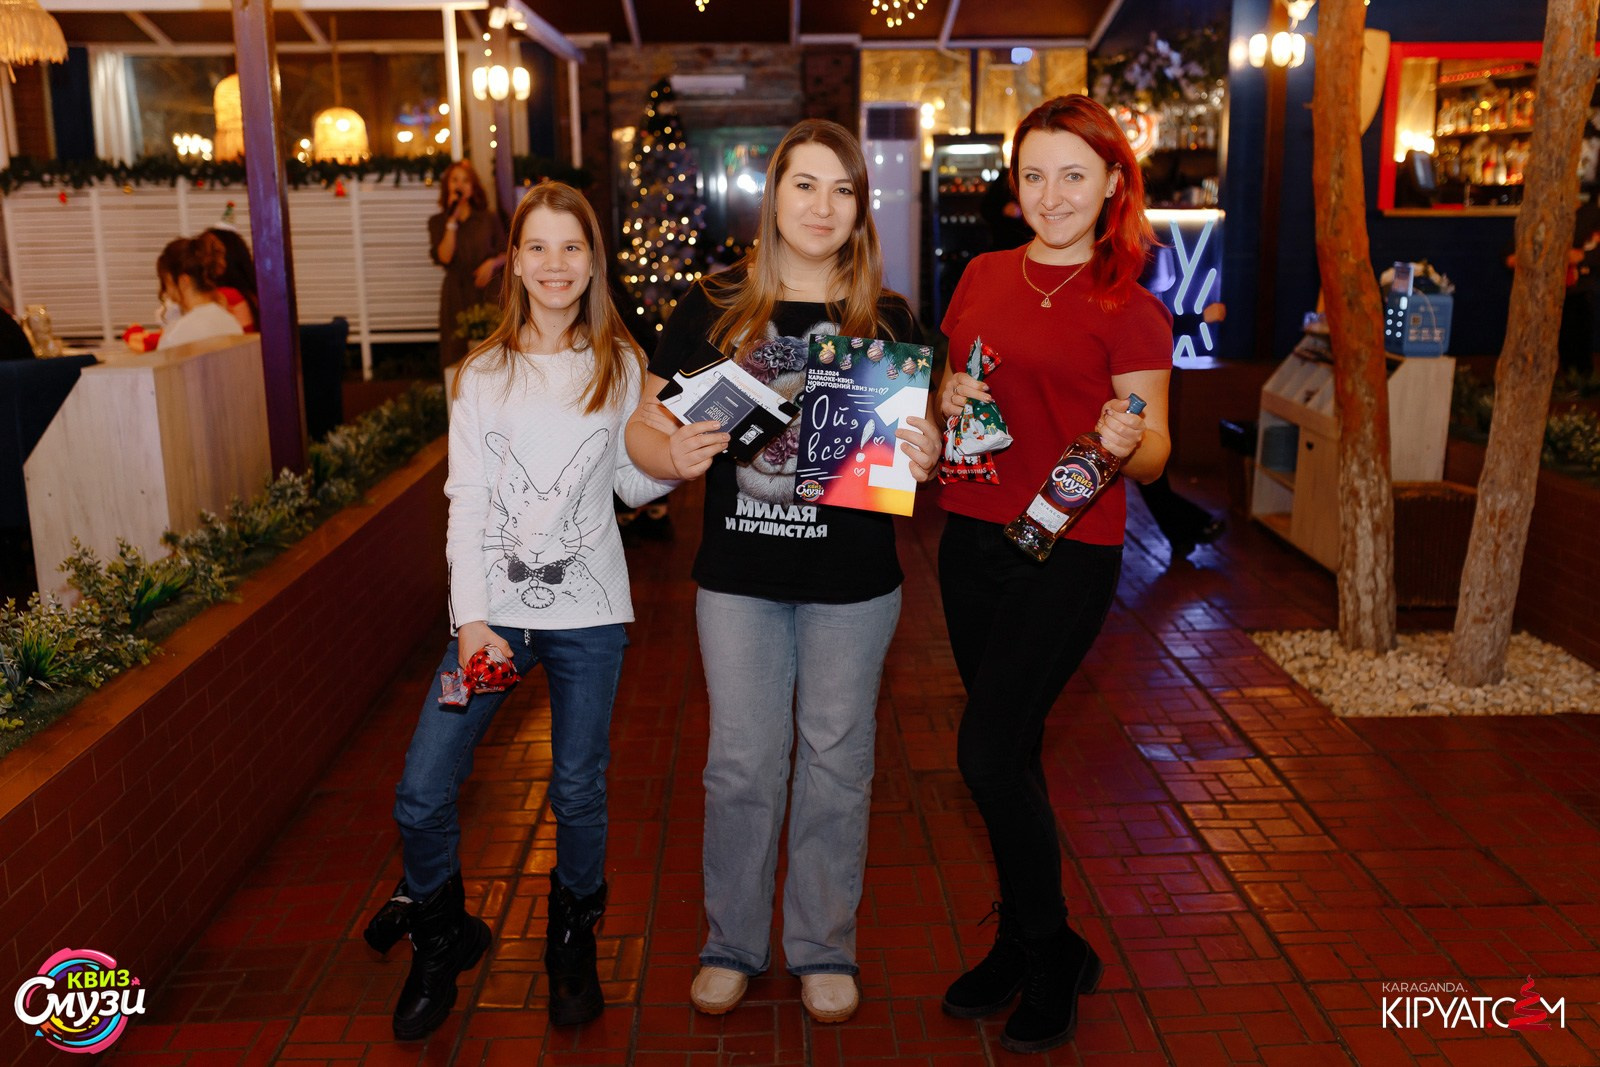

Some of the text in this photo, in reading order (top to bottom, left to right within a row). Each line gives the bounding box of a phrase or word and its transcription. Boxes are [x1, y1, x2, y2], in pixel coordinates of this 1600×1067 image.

[808, 368, 839, 376] 21.12.2024
[808, 374, 854, 384] КАРАОКЕ-КВИЗ:
[807, 380, 851, 390] НОВОГОДНИЙ
[1051, 465, 1094, 499] Смузи
[1071, 472, 1093, 488] КВИЗ
[796, 484, 824, 496] Смузи
[735, 498, 817, 522] МИЛАЯ
[725, 517, 828, 538] И ПУШИСТАЯ
